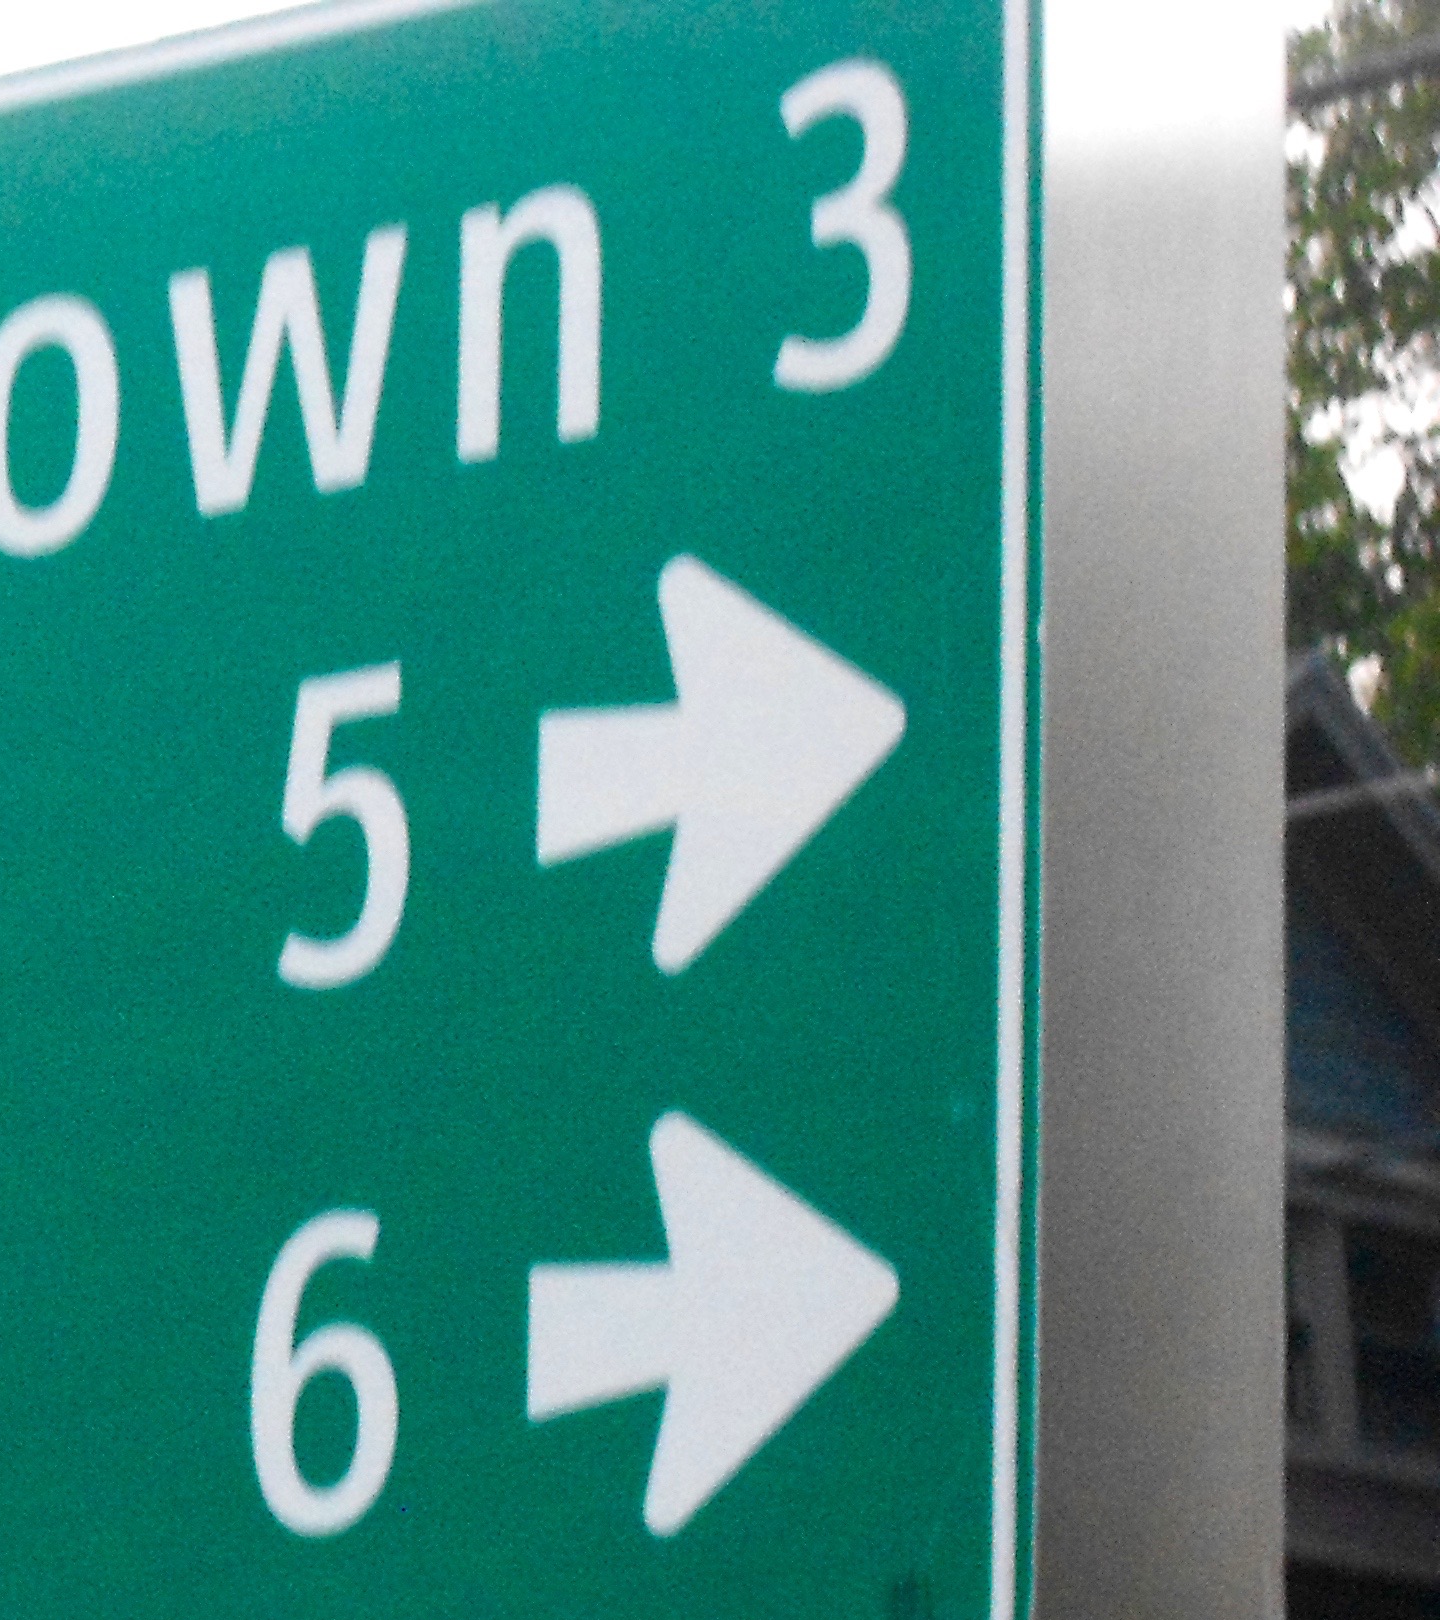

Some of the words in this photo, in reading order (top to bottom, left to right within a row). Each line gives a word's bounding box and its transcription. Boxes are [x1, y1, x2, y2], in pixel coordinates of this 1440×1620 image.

[773, 59, 913, 391] 3
[278, 662, 411, 988] 5
[250, 1210, 400, 1536] 6
